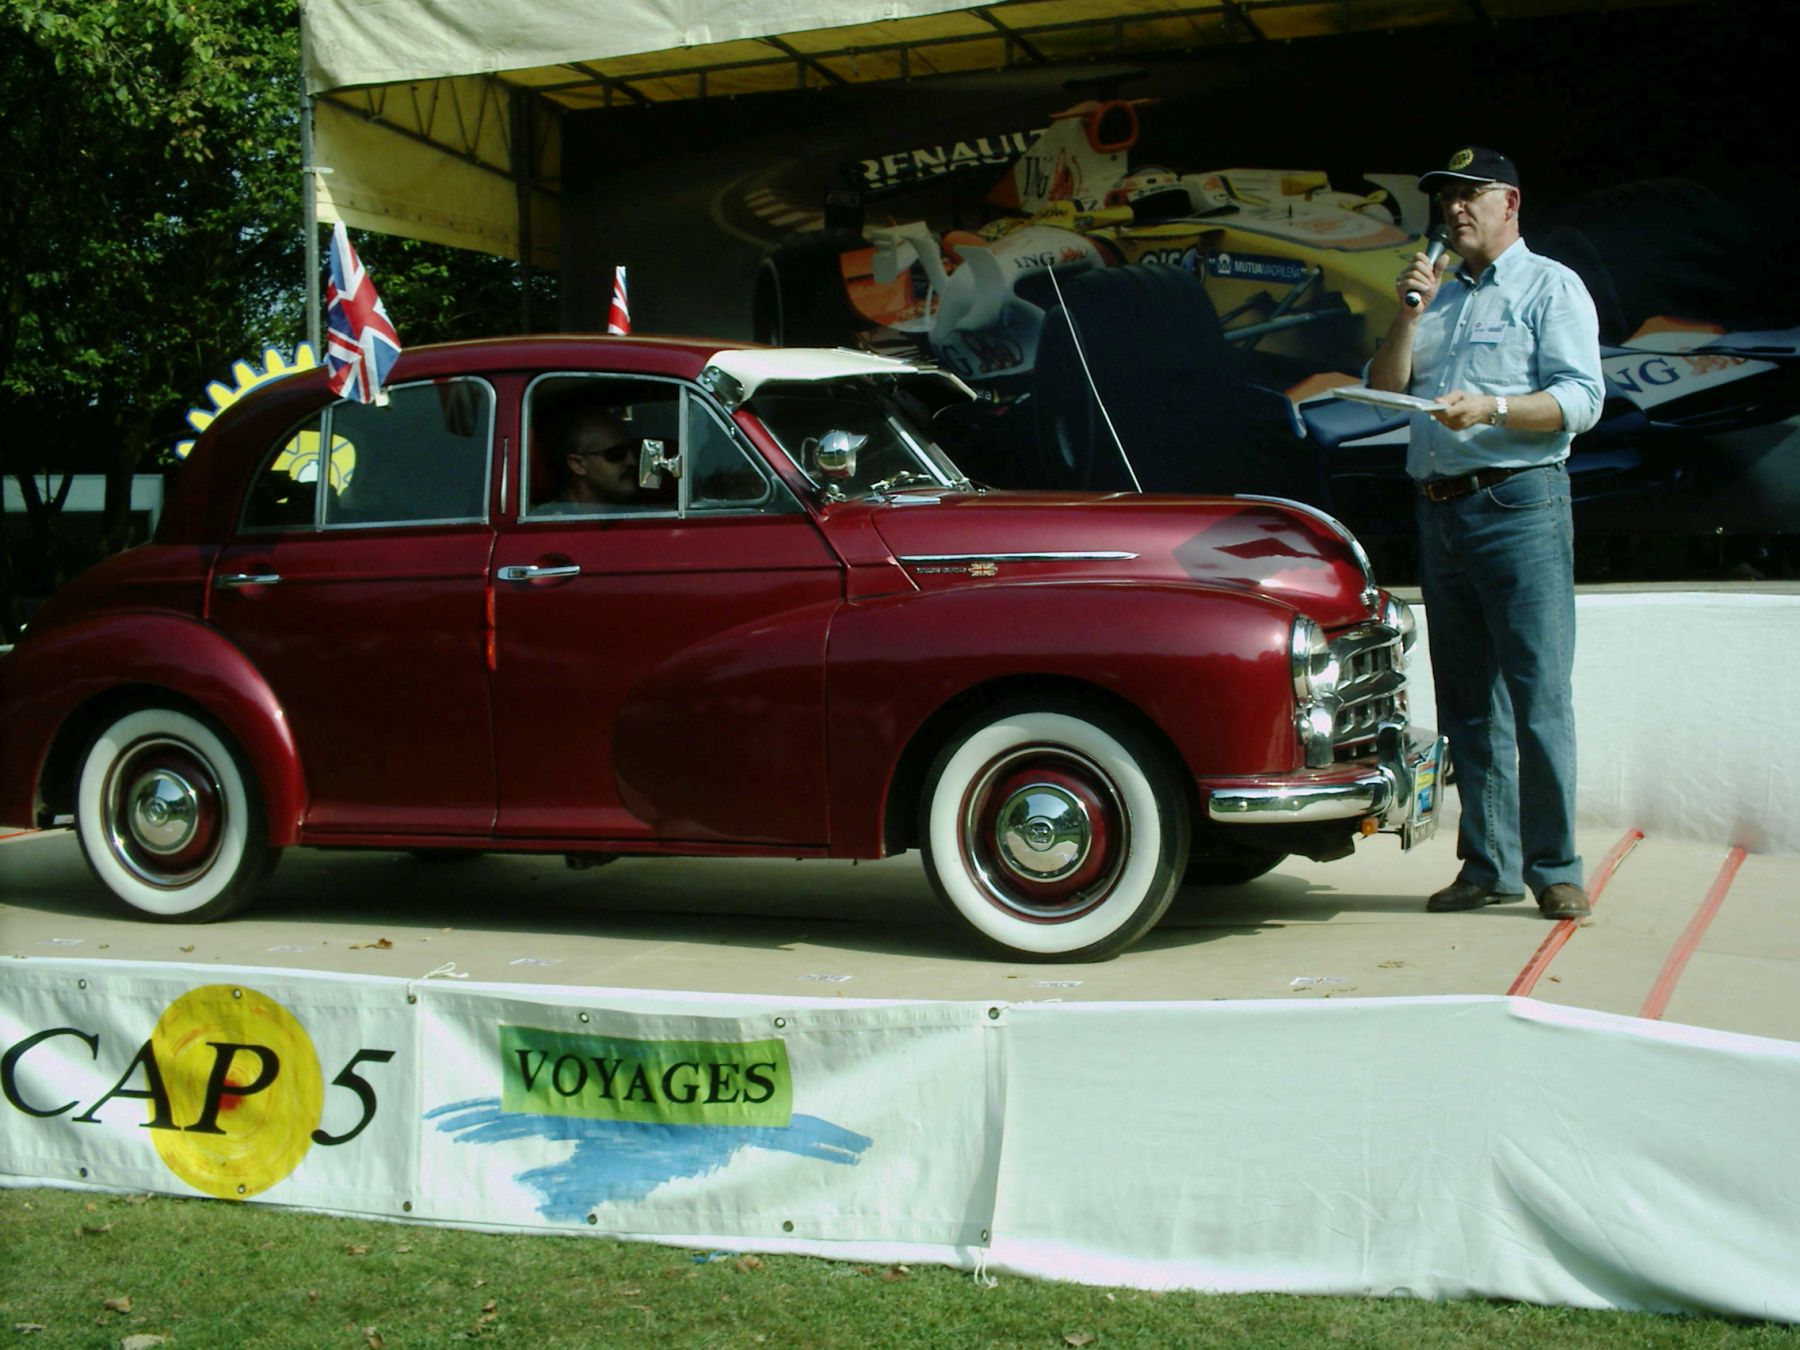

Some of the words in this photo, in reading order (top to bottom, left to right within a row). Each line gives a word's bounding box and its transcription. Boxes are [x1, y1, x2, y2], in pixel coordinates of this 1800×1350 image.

[1014, 251, 1055, 269] ING
[1612, 357, 1681, 394] NG
[0, 1027, 281, 1136] CAP
[310, 1048, 397, 1146] 5
[514, 1049, 777, 1105] VOYAGES
